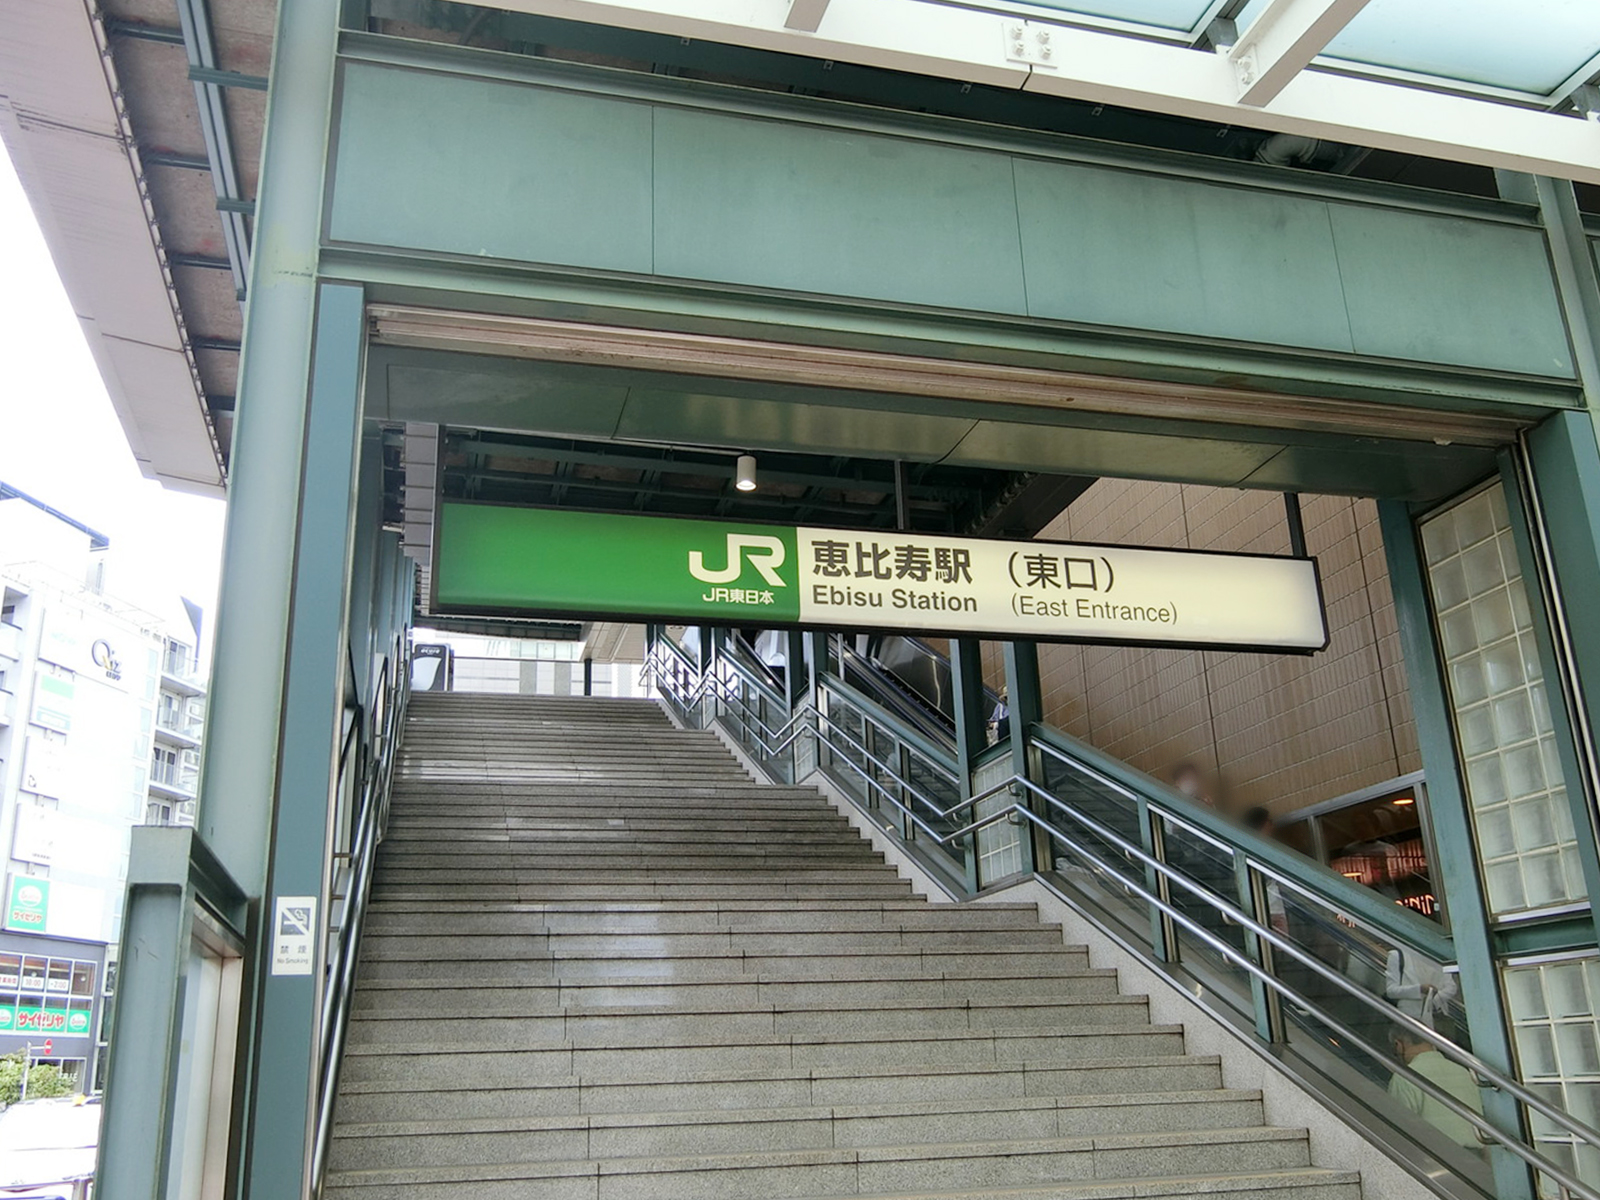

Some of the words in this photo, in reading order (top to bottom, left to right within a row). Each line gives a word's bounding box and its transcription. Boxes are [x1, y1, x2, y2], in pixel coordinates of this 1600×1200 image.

[688, 533, 787, 587] JR
[811, 539, 973, 585] 恵比寿駅
[702, 587, 775, 605] JR東日本
[812, 584, 883, 608] Ebisu
[892, 587, 978, 612] Station
[1011, 593, 1069, 617] (East
[1076, 599, 1178, 625] Entrance)
[13, 911, 43, 922] サイゼリヤ
[285, 957, 309, 965] Smoking
[18, 1012, 65, 1028] サイゼリヤ
